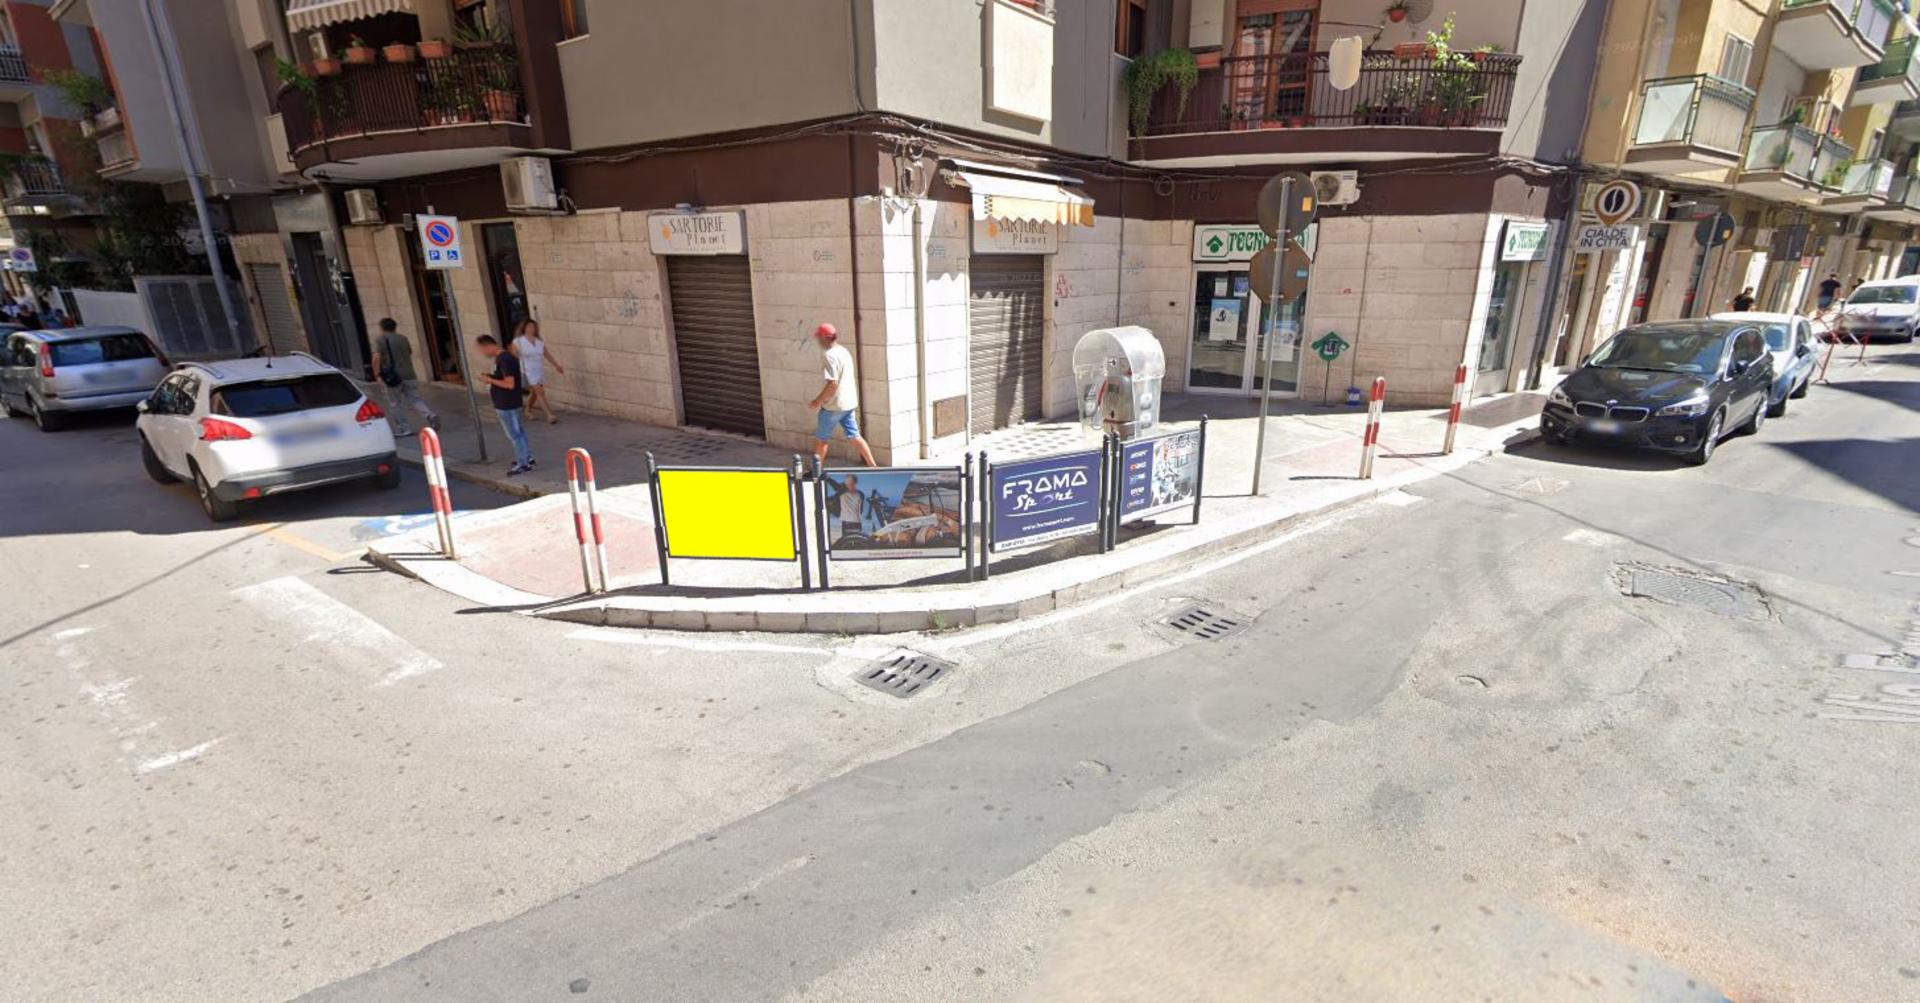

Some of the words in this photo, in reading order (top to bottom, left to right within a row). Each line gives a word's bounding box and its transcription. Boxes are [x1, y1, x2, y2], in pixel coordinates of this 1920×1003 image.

[669, 216, 727, 234] SARTORIE
[686, 233, 727, 246] Planet
[1012, 233, 1048, 246] Planet
[1585, 228, 1628, 239] CIALDE
[1580, 238, 1594, 247] IN
[1002, 470, 1088, 499] FRAMA
